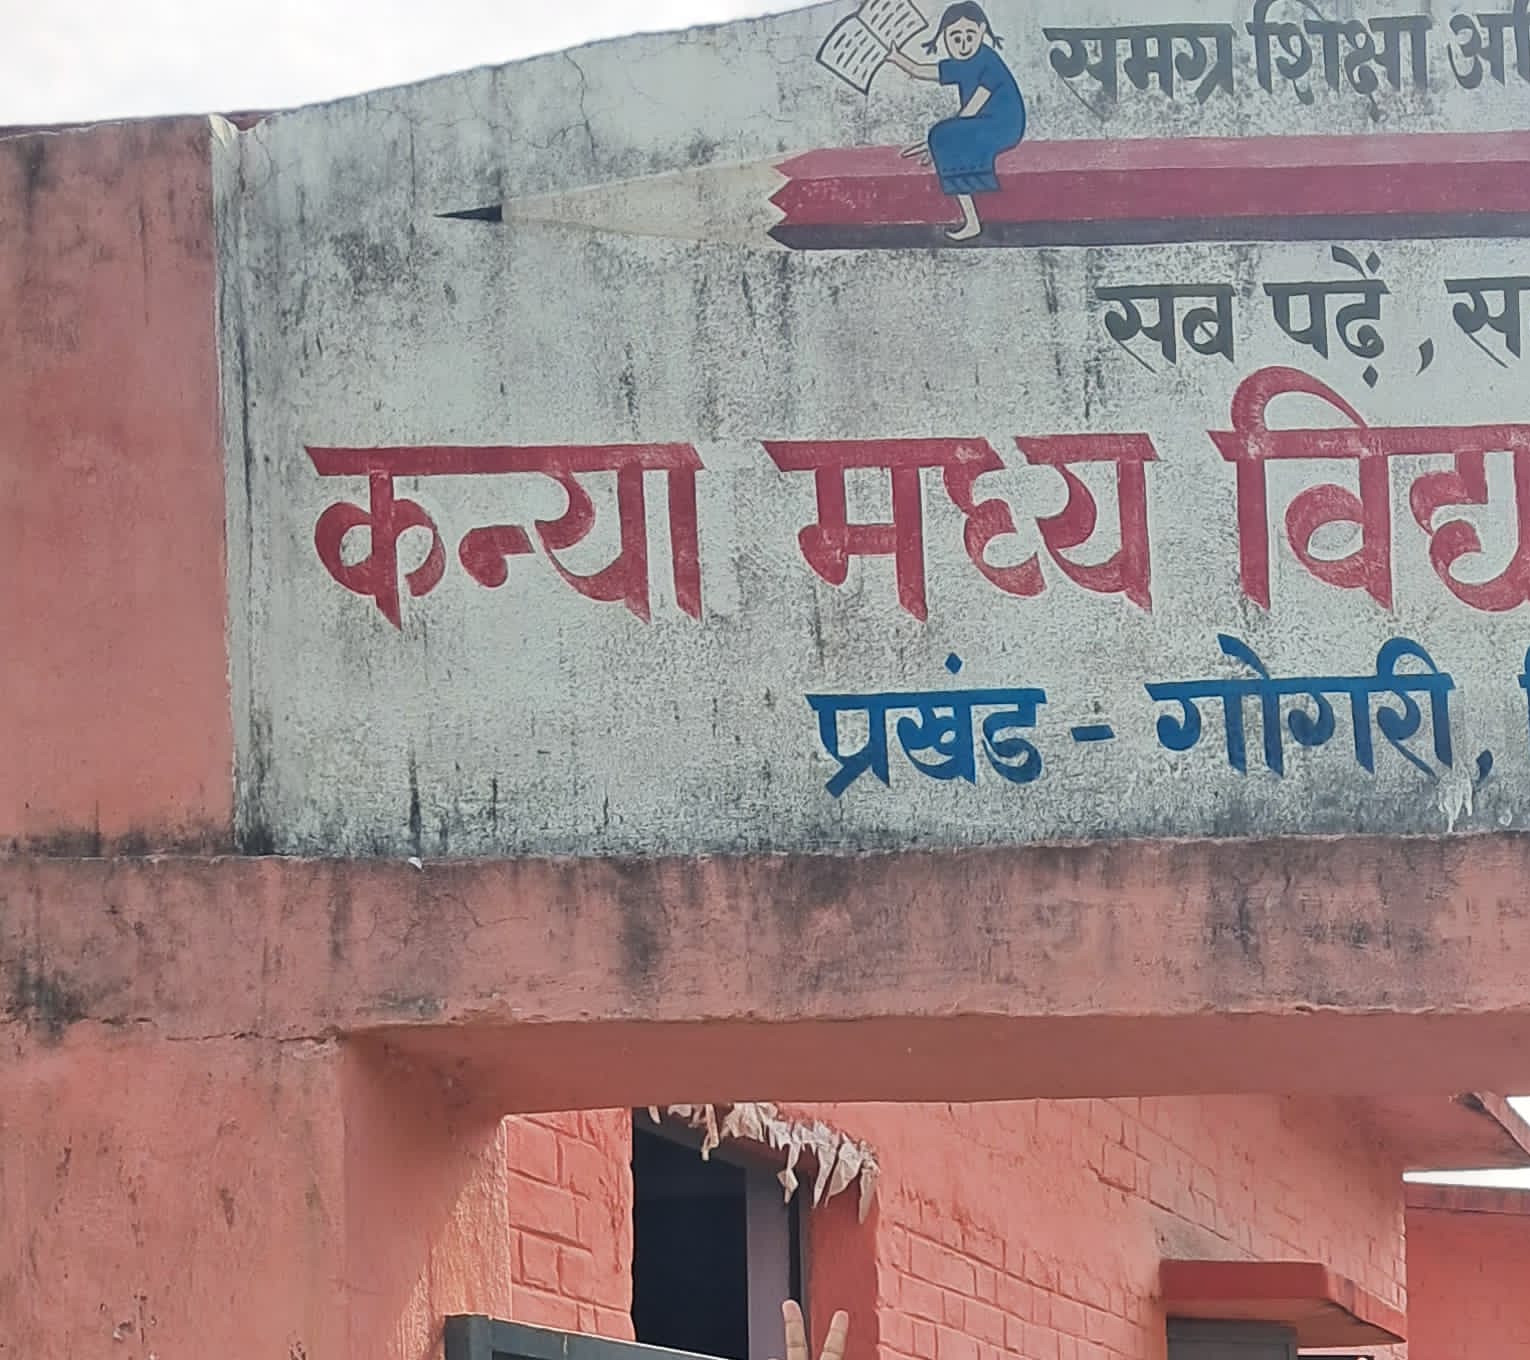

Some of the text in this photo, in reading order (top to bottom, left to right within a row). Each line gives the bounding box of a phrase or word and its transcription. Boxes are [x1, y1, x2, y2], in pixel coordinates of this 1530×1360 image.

[1042, 23, 1236, 114] समग्र
[1246, 0, 1432, 120] शिक्षा
[1094, 284, 1235, 373] सब
[303, 442, 703, 630] कन्या
[763, 432, 1158, 620] मध्य
[806, 653, 1046, 797] प्रखंड
